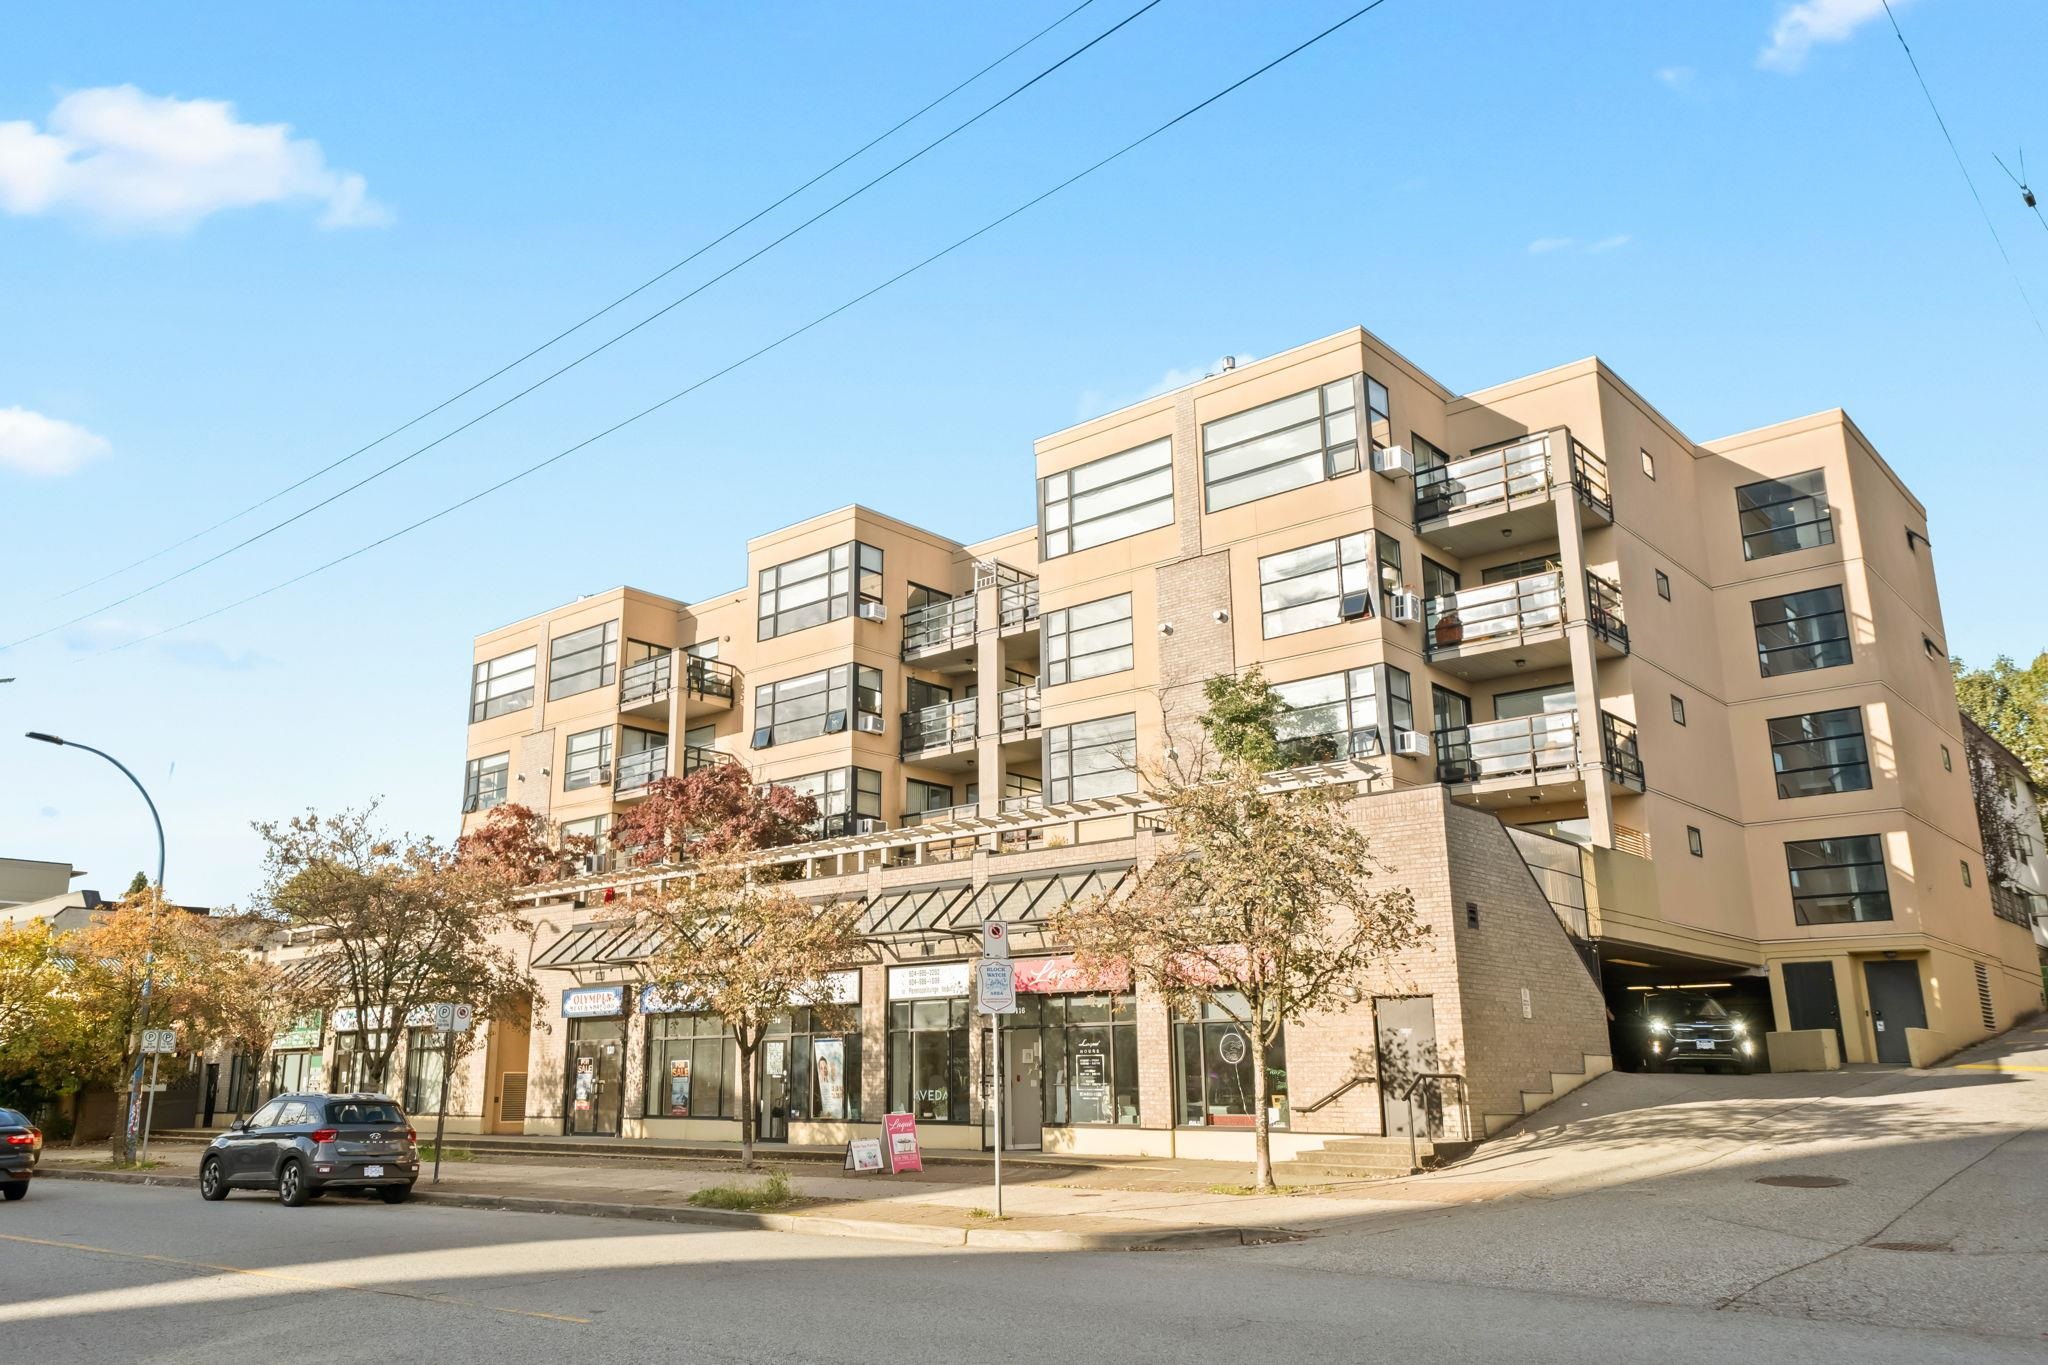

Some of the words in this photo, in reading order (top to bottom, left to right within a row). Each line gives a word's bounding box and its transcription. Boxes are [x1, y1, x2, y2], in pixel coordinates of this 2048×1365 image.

[578, 1064, 592, 1073] SALE
[672, 1067, 689, 1076] SALE
[914, 1089, 949, 1101] AVEDA
